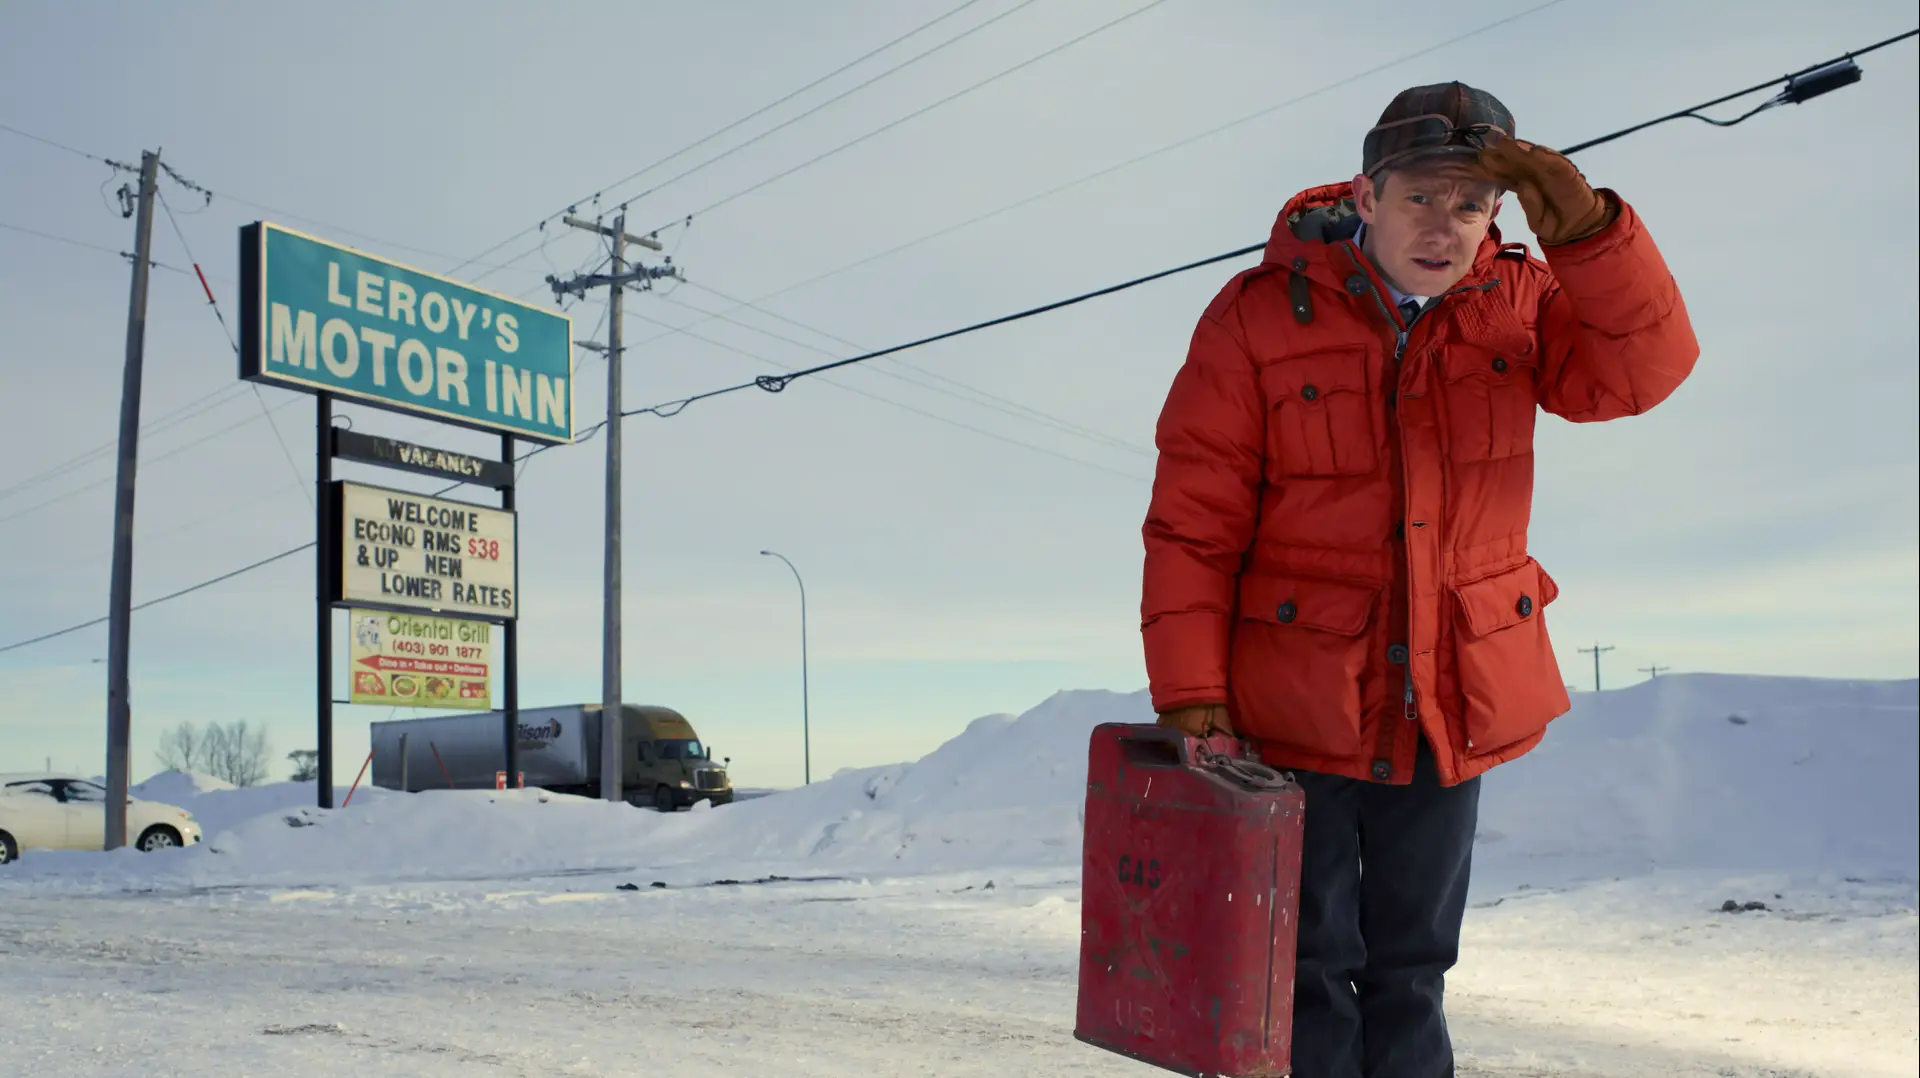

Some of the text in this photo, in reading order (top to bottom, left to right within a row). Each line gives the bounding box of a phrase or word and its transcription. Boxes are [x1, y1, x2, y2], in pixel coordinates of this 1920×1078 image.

[327, 261, 520, 353] LEROY'S
[271, 302, 566, 429] MOTOR INN
[398, 445, 485, 477] VACANCY
[387, 498, 479, 533] WELCOME
[354, 517, 499, 561] ECONO RMS $38
[424, 553, 463, 579] NEW
[381, 573, 512, 609] LOWER RATES
[387, 615, 490, 644] Oriental Grill
[392, 639, 482, 659] (403) 901 1877
[454, 662, 485, 676] Delivery
[1117, 853, 1161, 890] GAS
